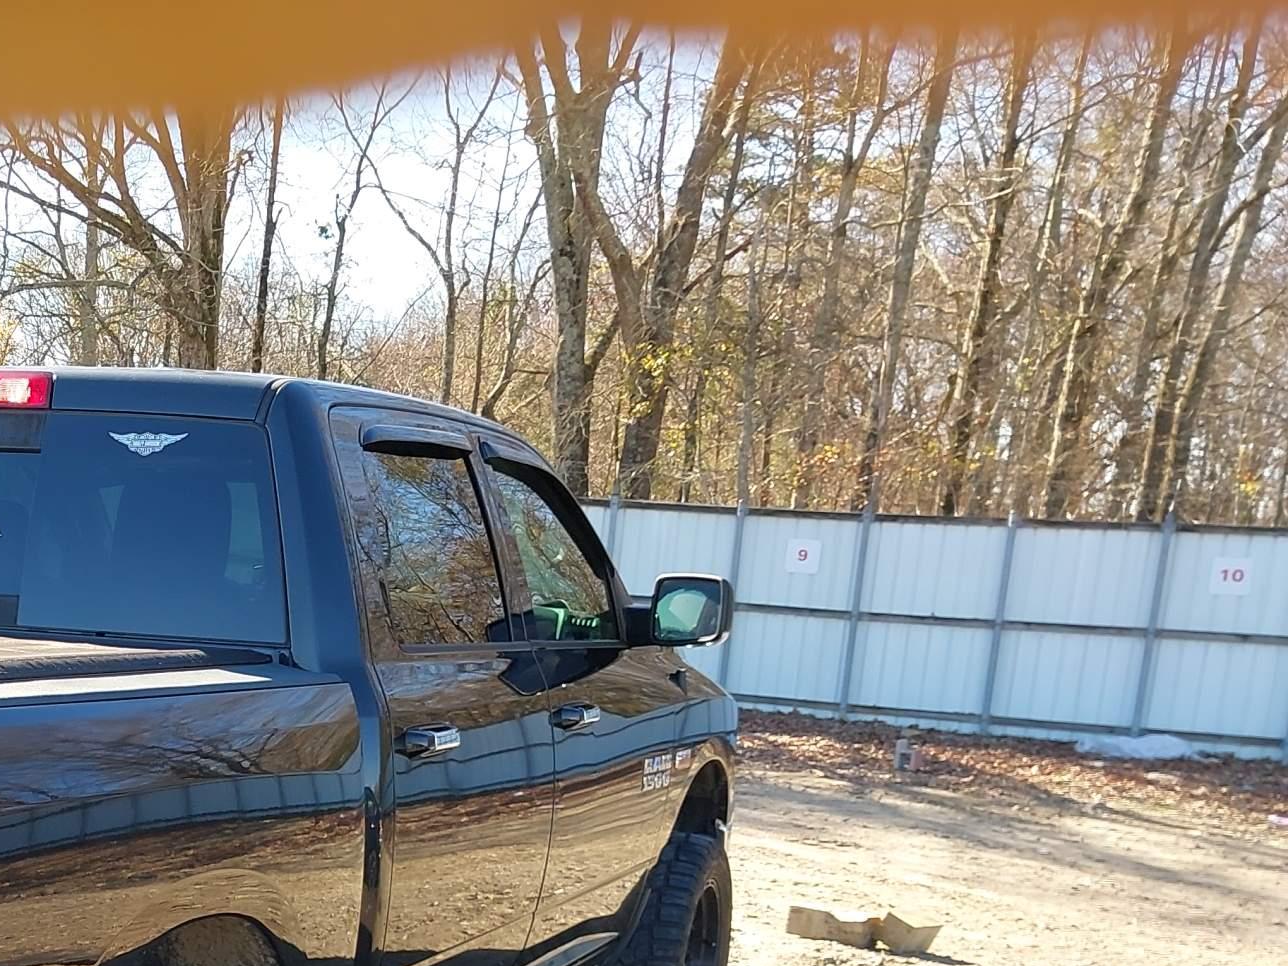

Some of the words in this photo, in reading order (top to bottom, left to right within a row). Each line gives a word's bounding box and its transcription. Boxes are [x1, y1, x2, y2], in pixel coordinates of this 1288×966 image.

[798, 549, 808, 562] 9
[1220, 569, 1244, 582] 10
[643, 754, 673, 775] RAM
[641, 770, 671, 792] 1500
